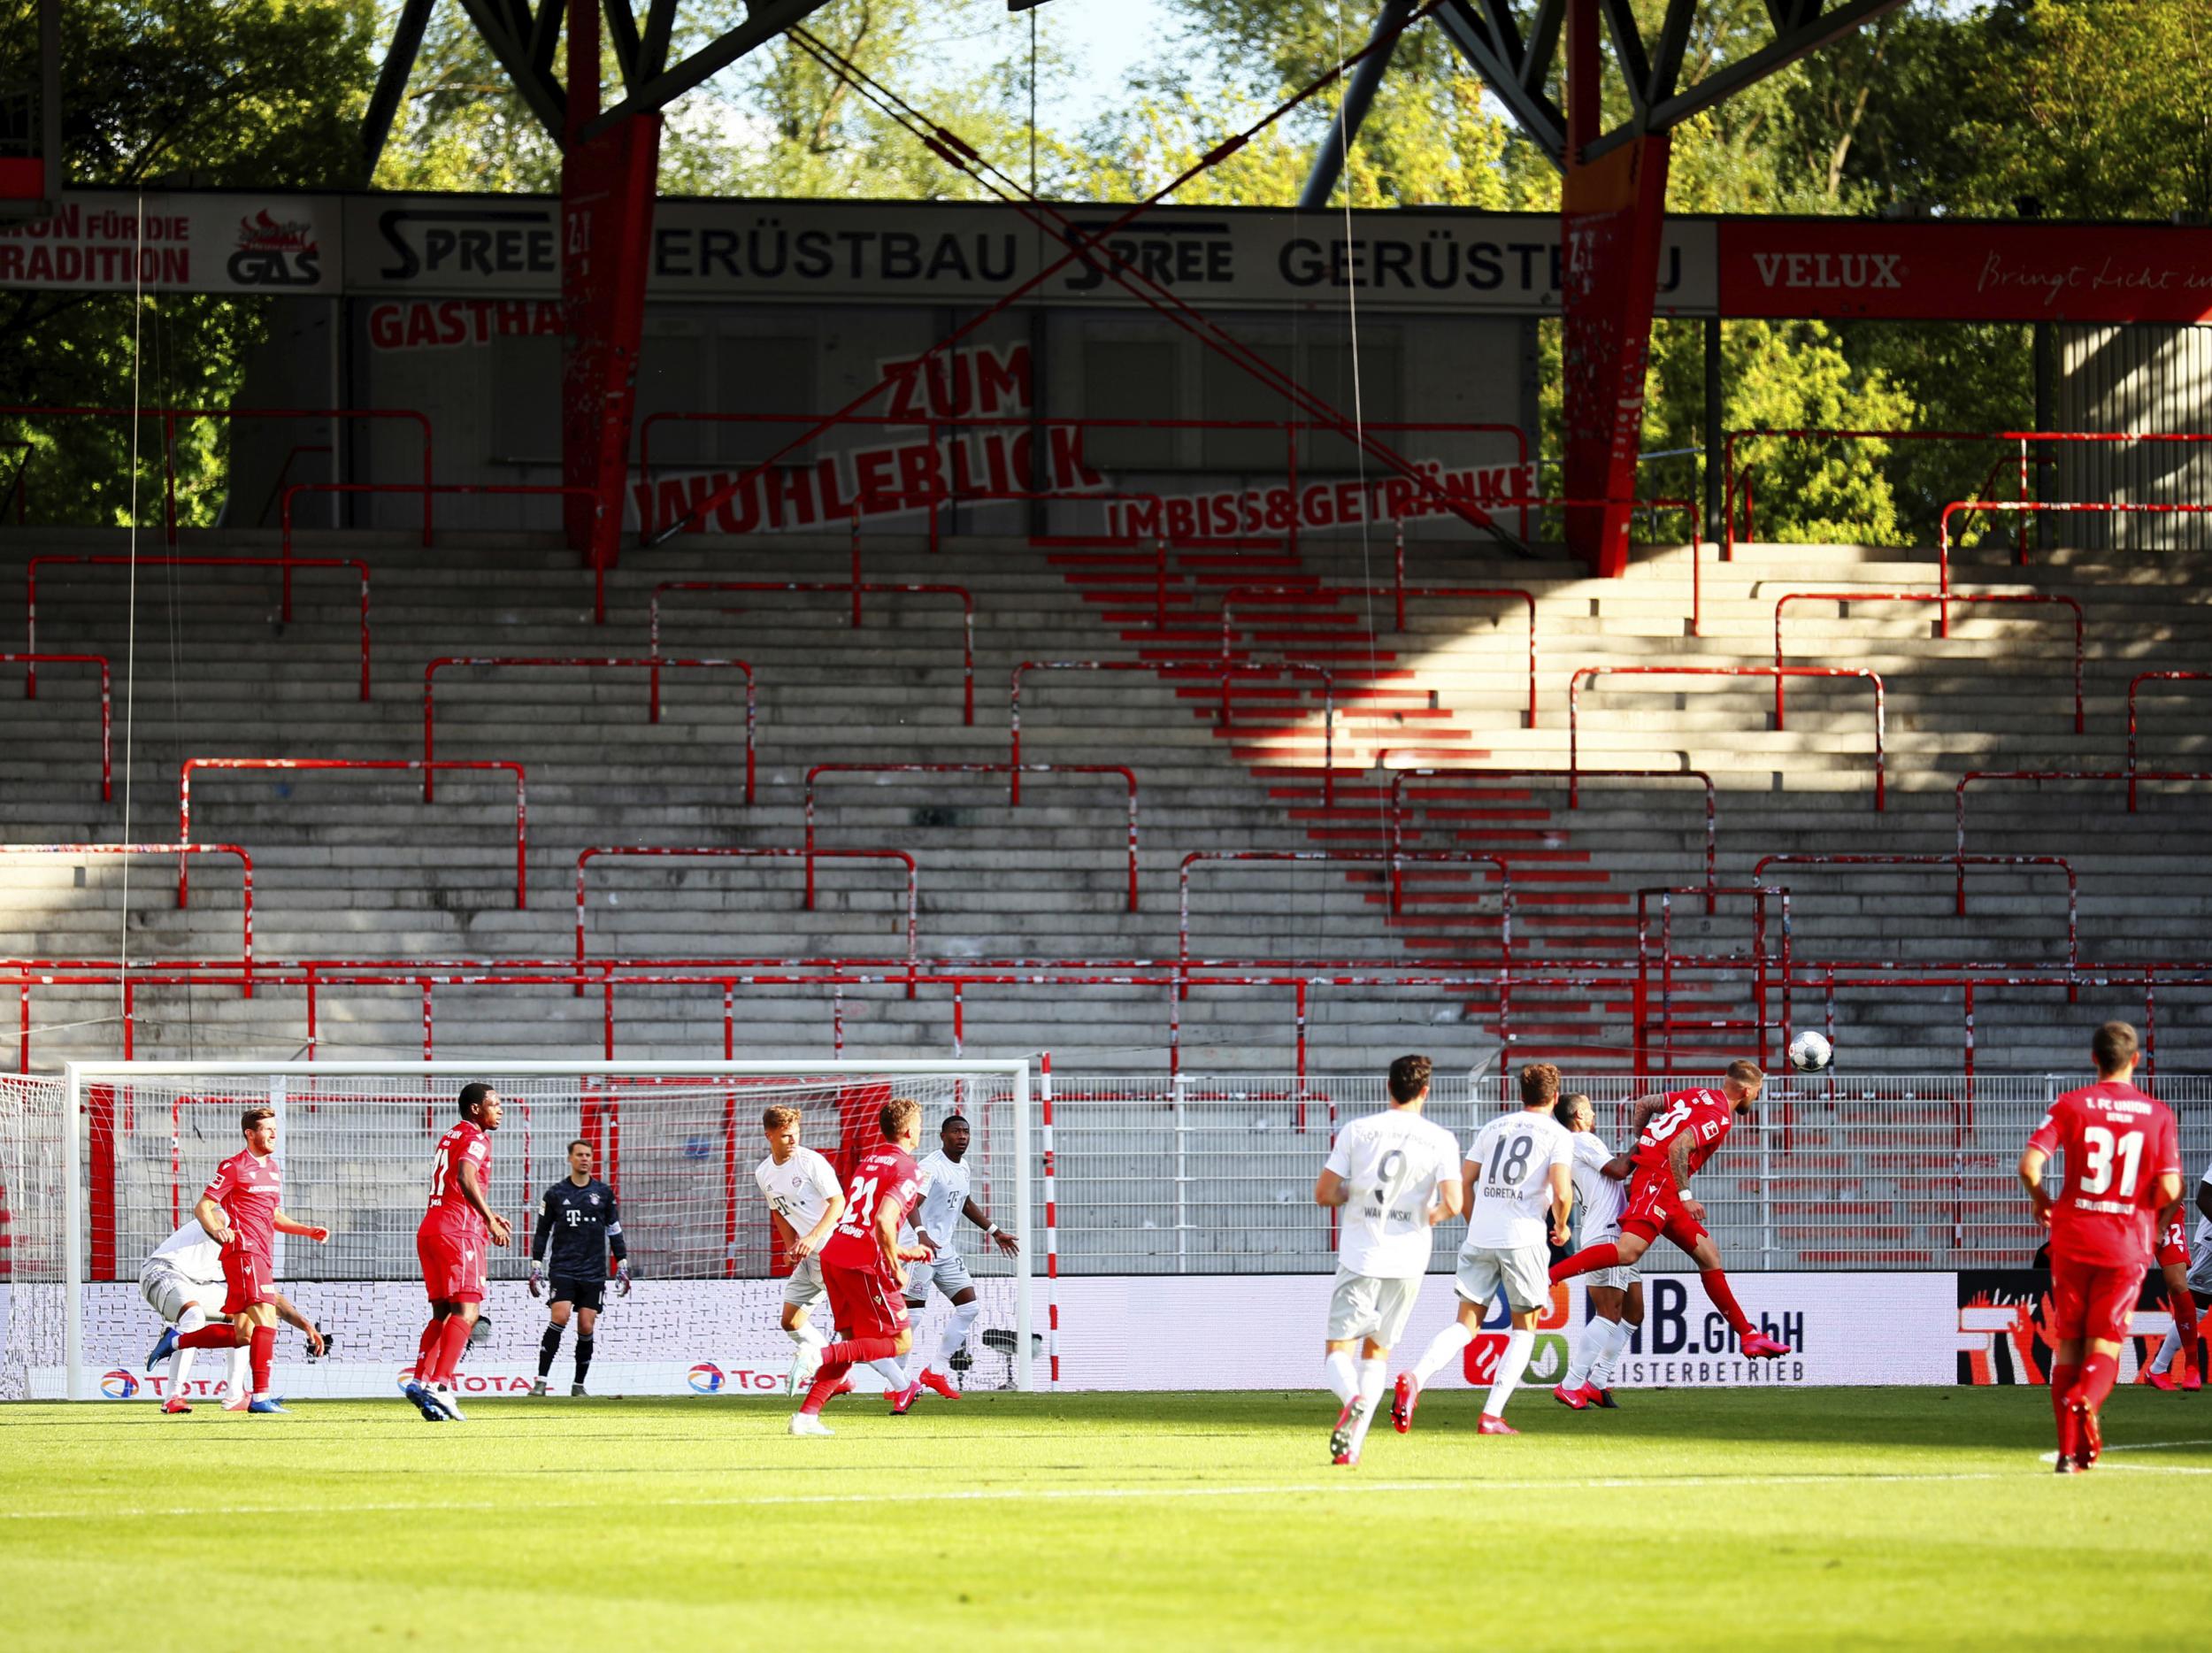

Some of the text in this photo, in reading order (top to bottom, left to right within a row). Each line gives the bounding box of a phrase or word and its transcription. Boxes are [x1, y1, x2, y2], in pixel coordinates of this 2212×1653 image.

[87, 211, 138, 241] FÜR
[145, 218, 189, 241] DIE
[380, 211, 554, 279] SPREE
[655, 218, 1017, 281] ERÜSTBAU
[0, 245, 189, 284] RADITION
[227, 250, 321, 286] GAS
[1065, 222, 1233, 290] SPREE
[1978, 249, 2084, 306] Bringt
[371, 301, 564, 349] GASTHA
[882, 346, 1034, 421] ZUM
[633, 427, 1103, 533] WUHLEBLICK
[1374, 1149, 1408, 1205] 9
[1488, 1134, 1533, 1186] 18
[2080, 1126, 2145, 1197] 31
[839, 1176, 879, 1226] 21
[1606, 1362, 1804, 1382] EISTERBETRIEB
